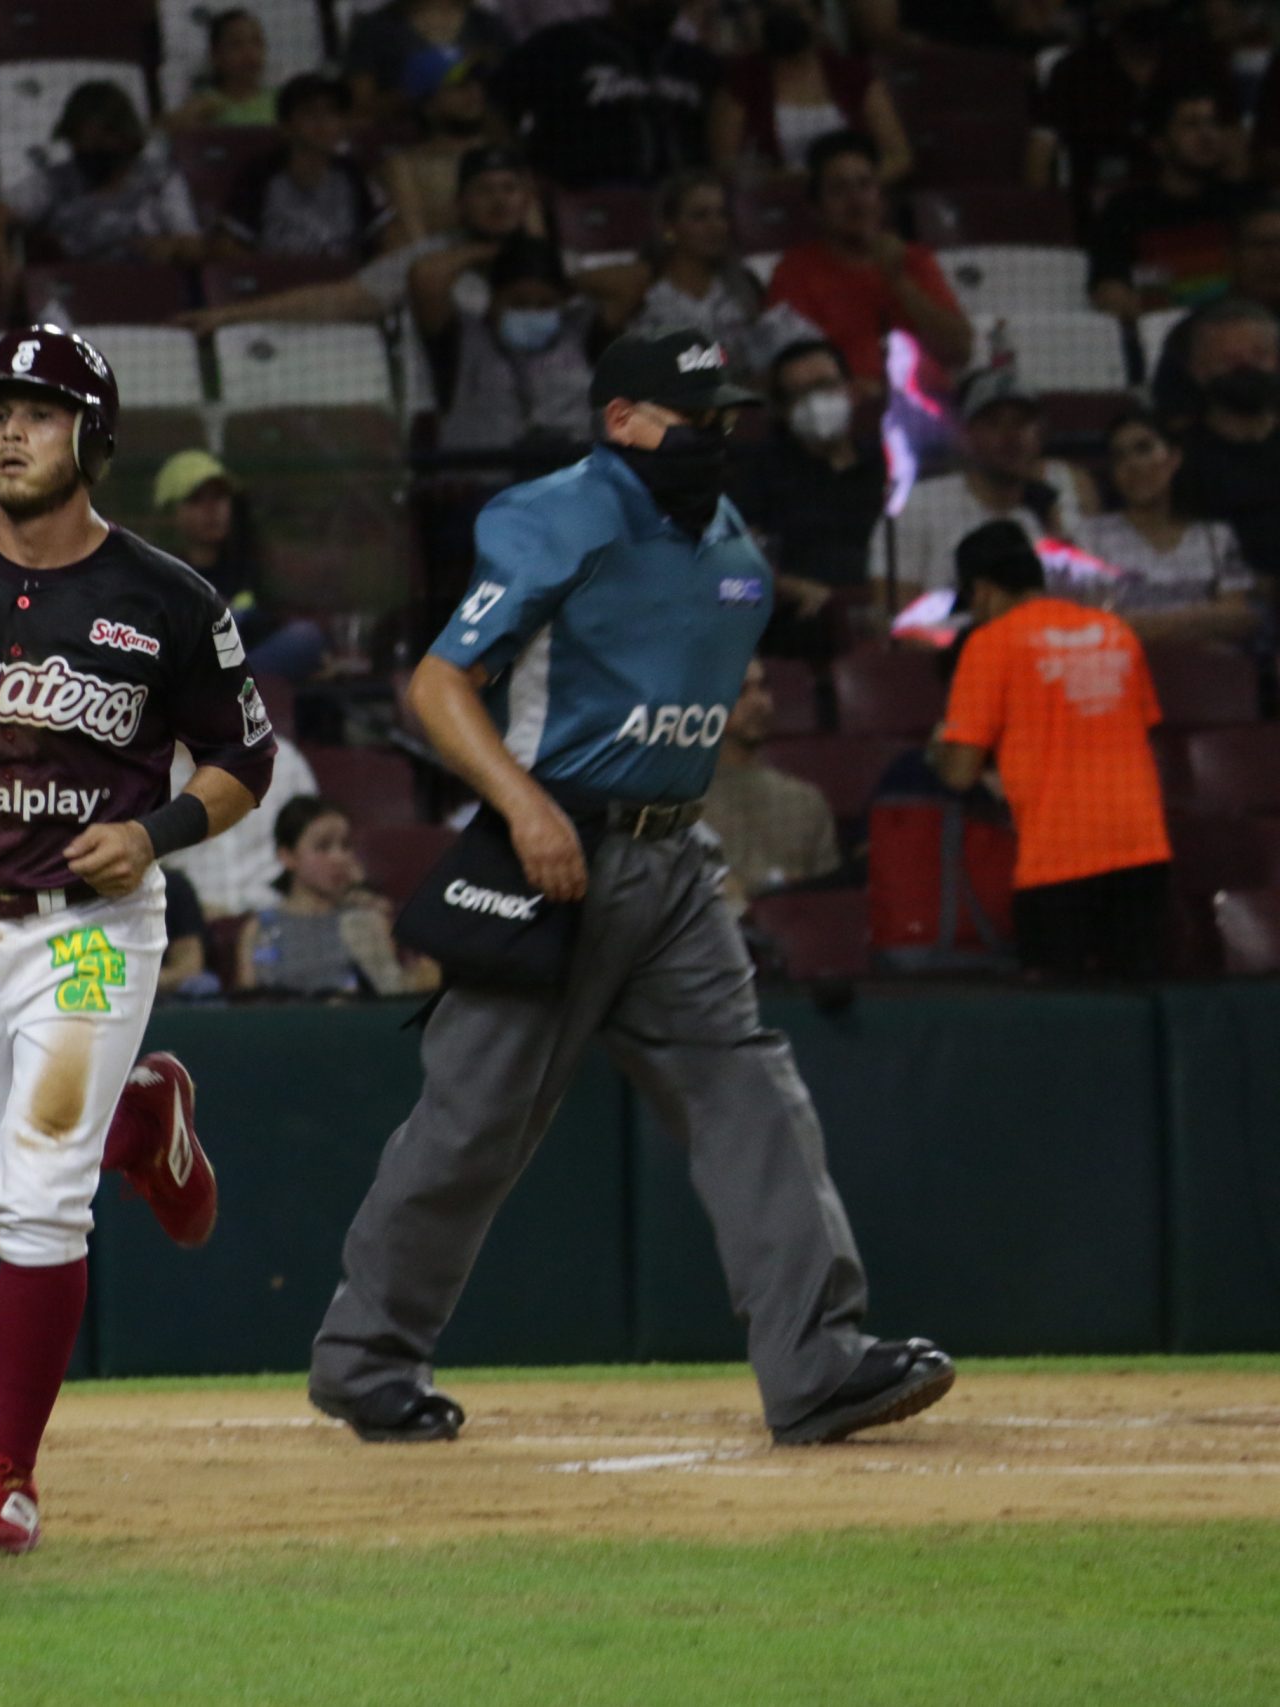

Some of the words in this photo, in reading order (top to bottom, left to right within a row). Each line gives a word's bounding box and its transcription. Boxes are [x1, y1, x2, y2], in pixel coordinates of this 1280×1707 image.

[460, 581, 507, 625] 47
[90, 618, 160, 655] SuKarne
[615, 703, 729, 748] ARCO
